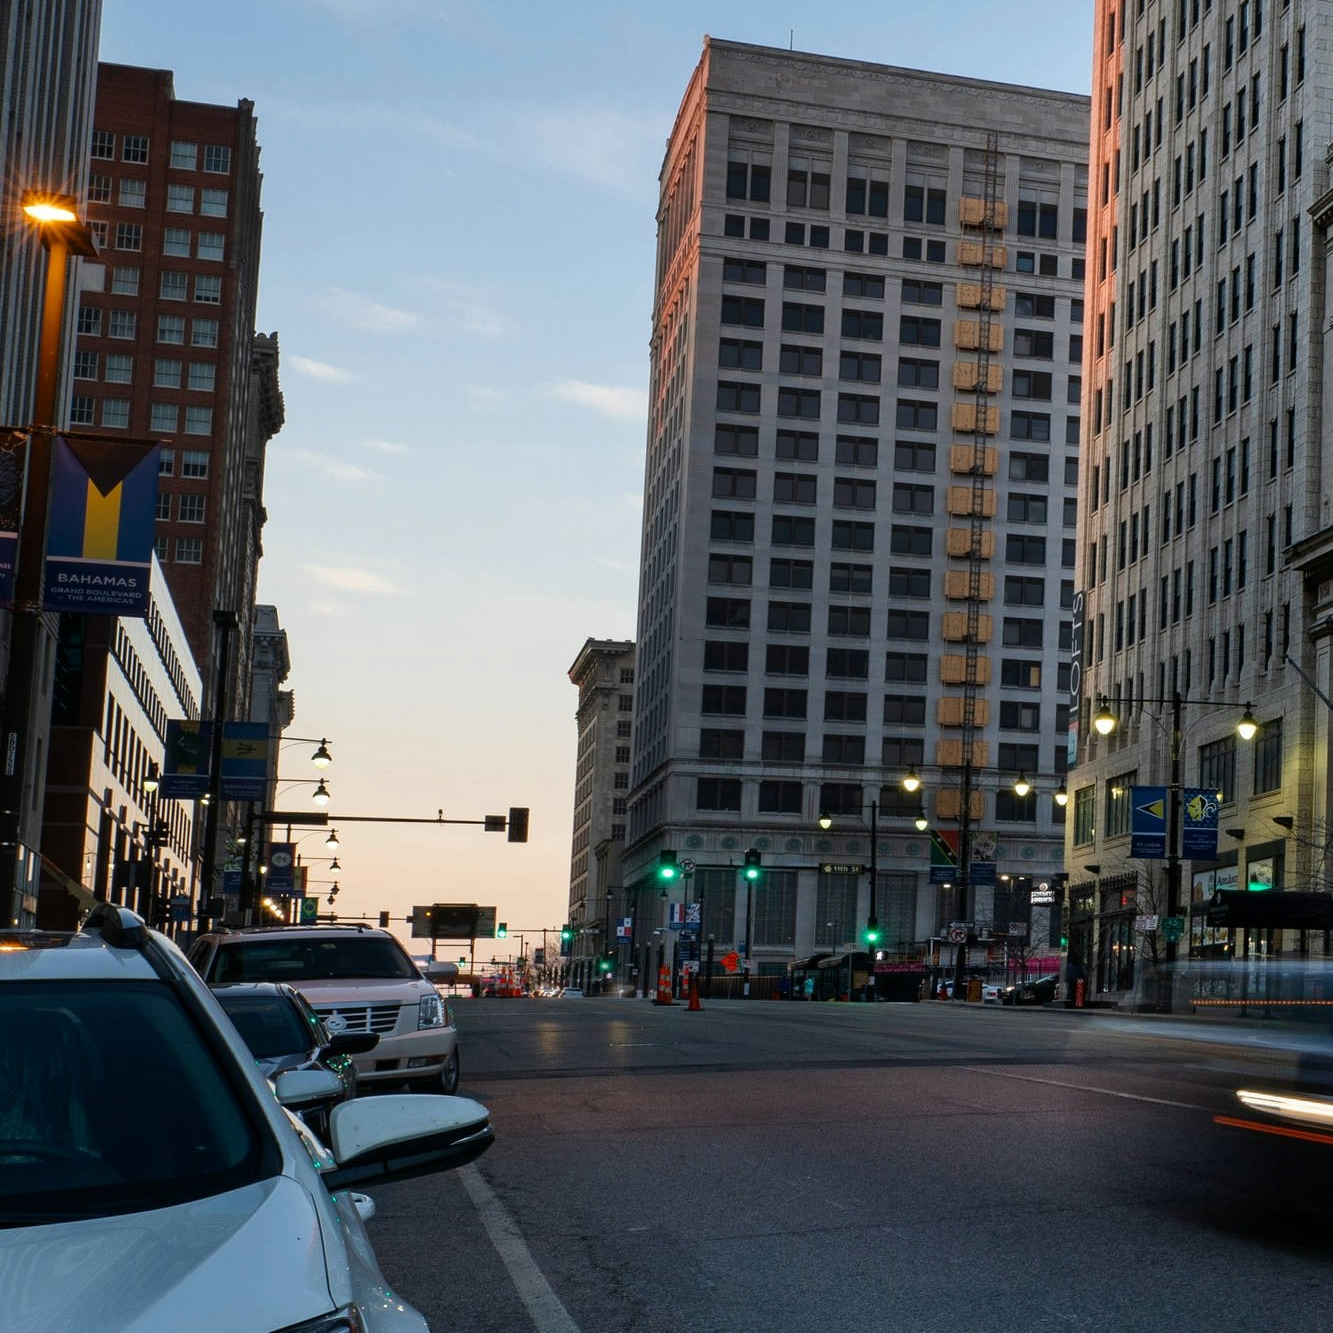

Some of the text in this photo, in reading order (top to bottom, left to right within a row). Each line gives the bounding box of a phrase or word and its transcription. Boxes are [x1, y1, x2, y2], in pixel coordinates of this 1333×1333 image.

[57, 572, 137, 587] BAHAMAS
[50, 586, 143, 599] GRAND BOULEVARD
[86, 595, 135, 604] AMERICAS
[1069, 593, 1083, 713] LOFTS
